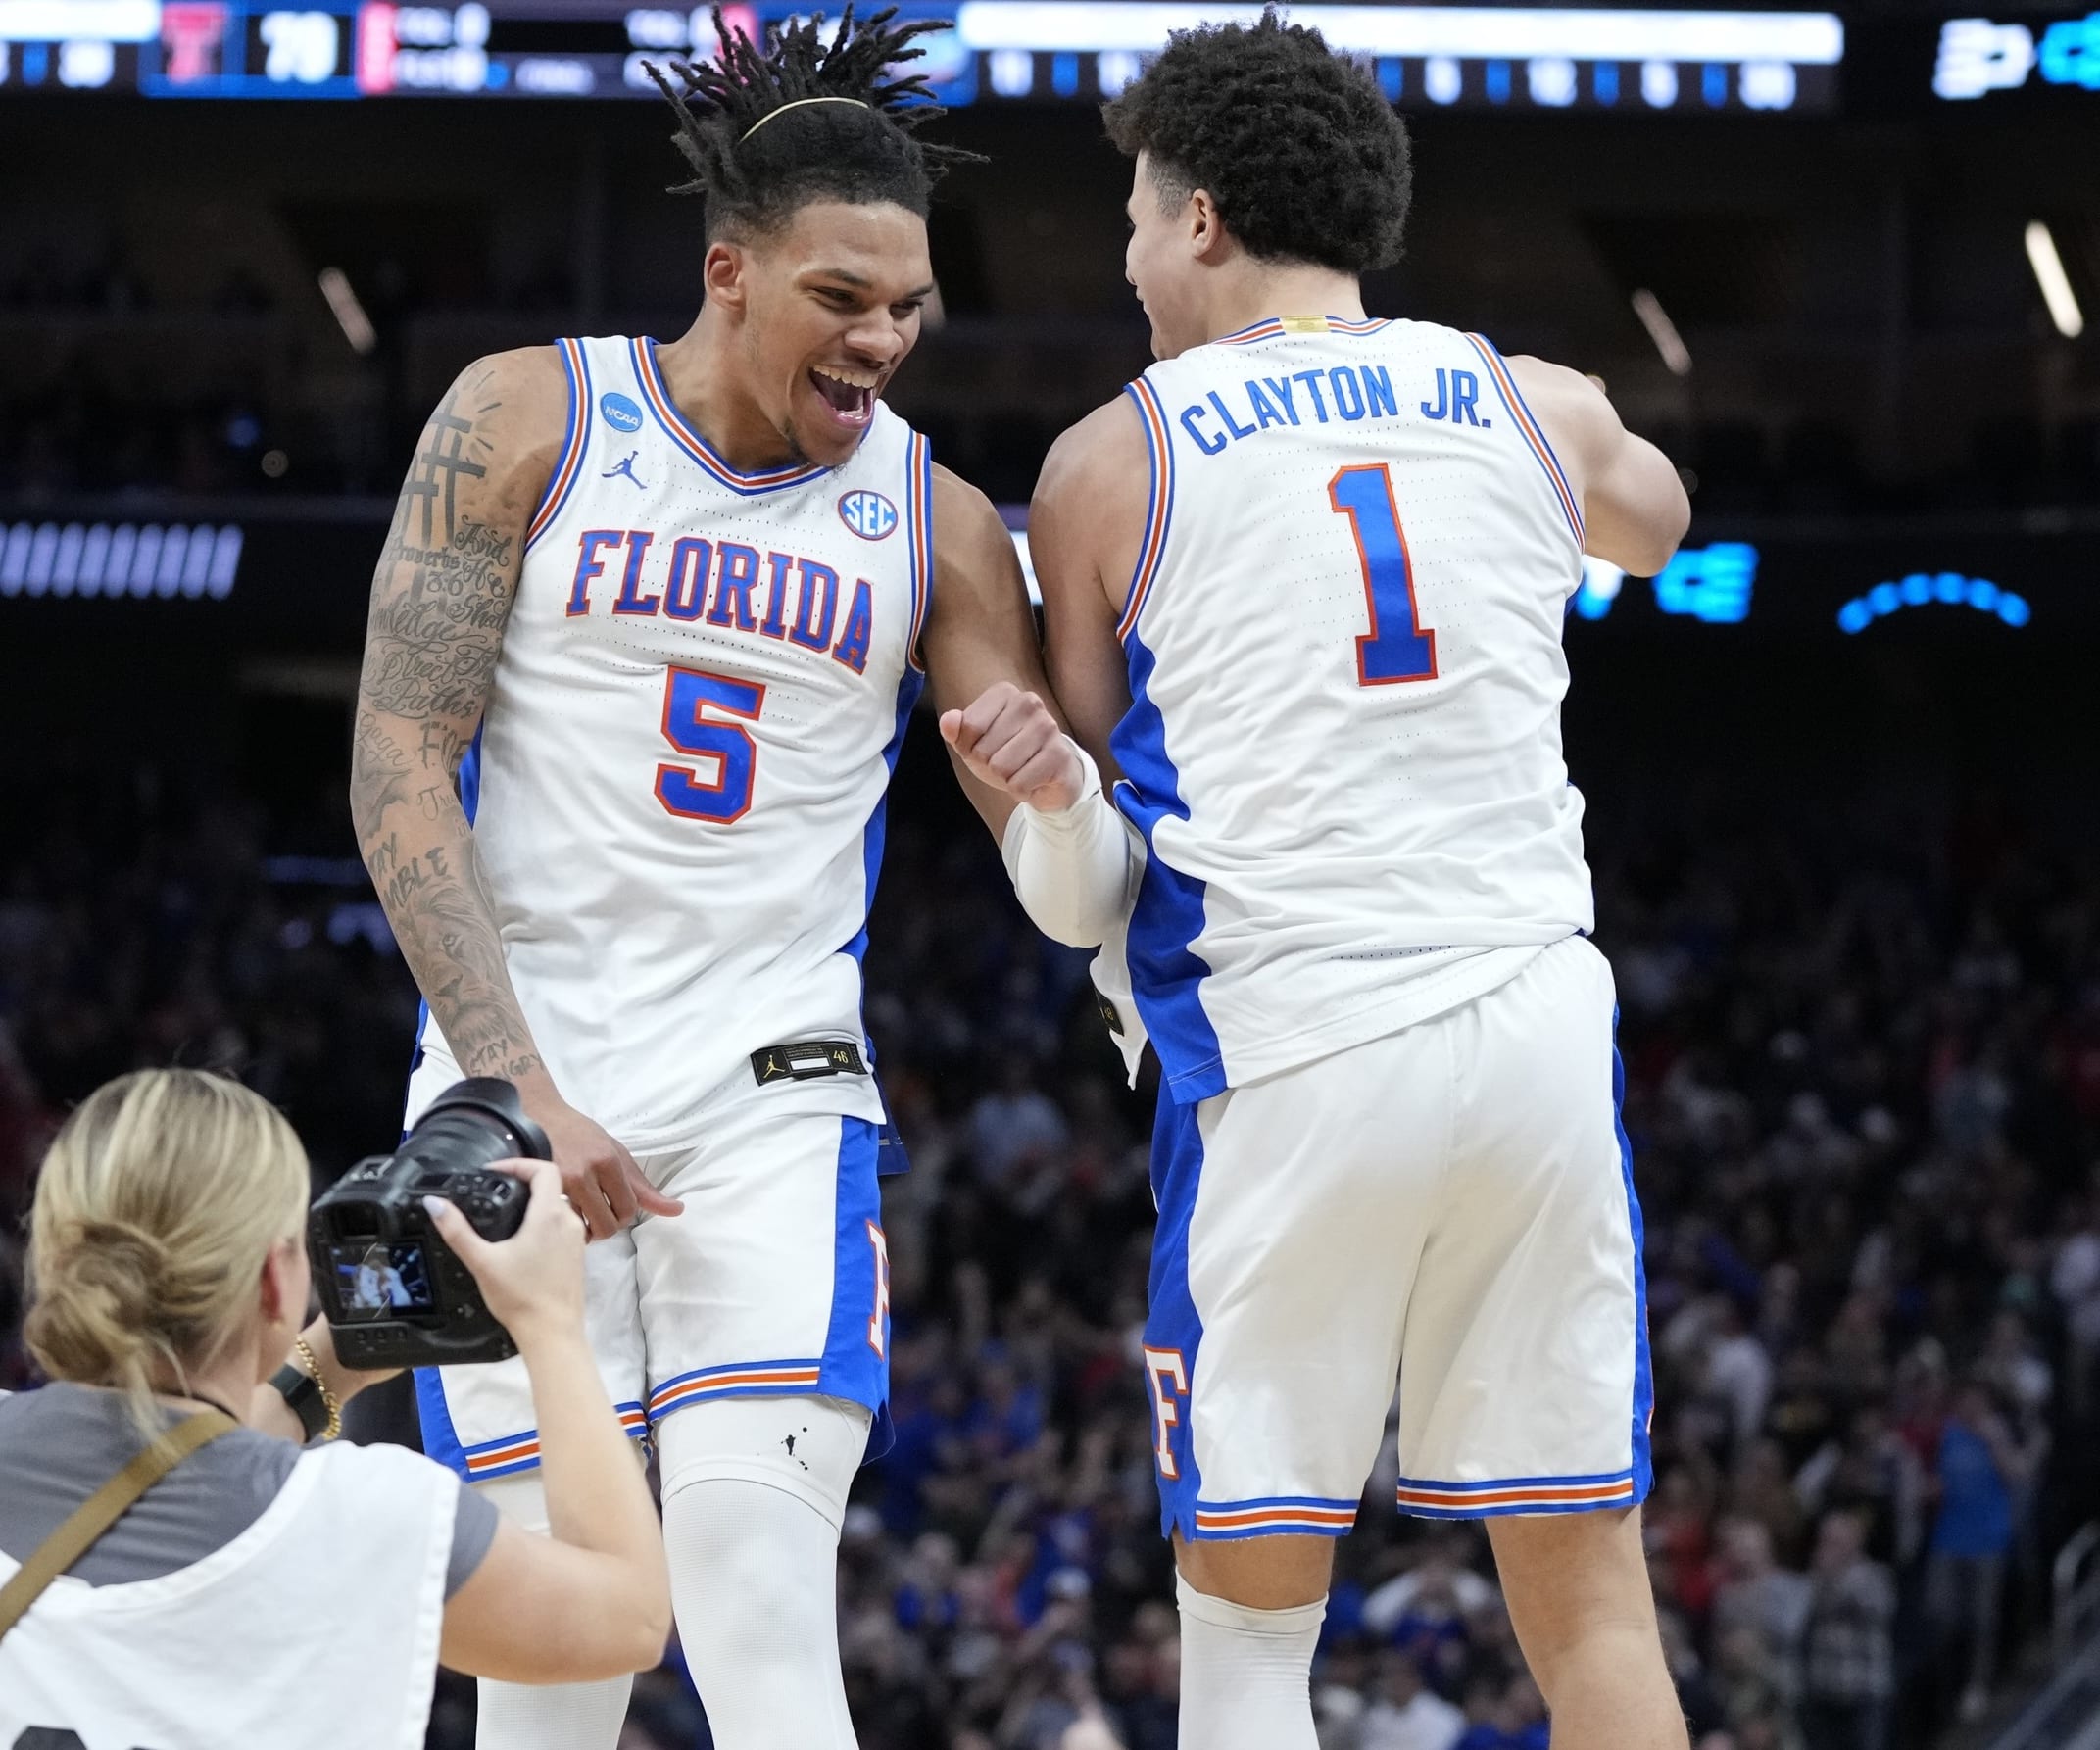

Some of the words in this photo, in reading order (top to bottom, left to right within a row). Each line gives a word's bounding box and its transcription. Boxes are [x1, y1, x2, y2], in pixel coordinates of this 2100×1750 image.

[605, 405, 639, 427] NCAA
[1180, 365, 1398, 455] CLAYTON
[1420, 368, 1491, 429] JR.
[455, 515, 511, 567] And
[845, 492, 894, 536] SEC
[565, 530, 872, 675] FLORIDA
[1327, 462, 1439, 687] 1
[372, 678, 480, 719] Paths
[654, 664, 766, 825] 5
[1142, 1344, 1189, 1481] F
